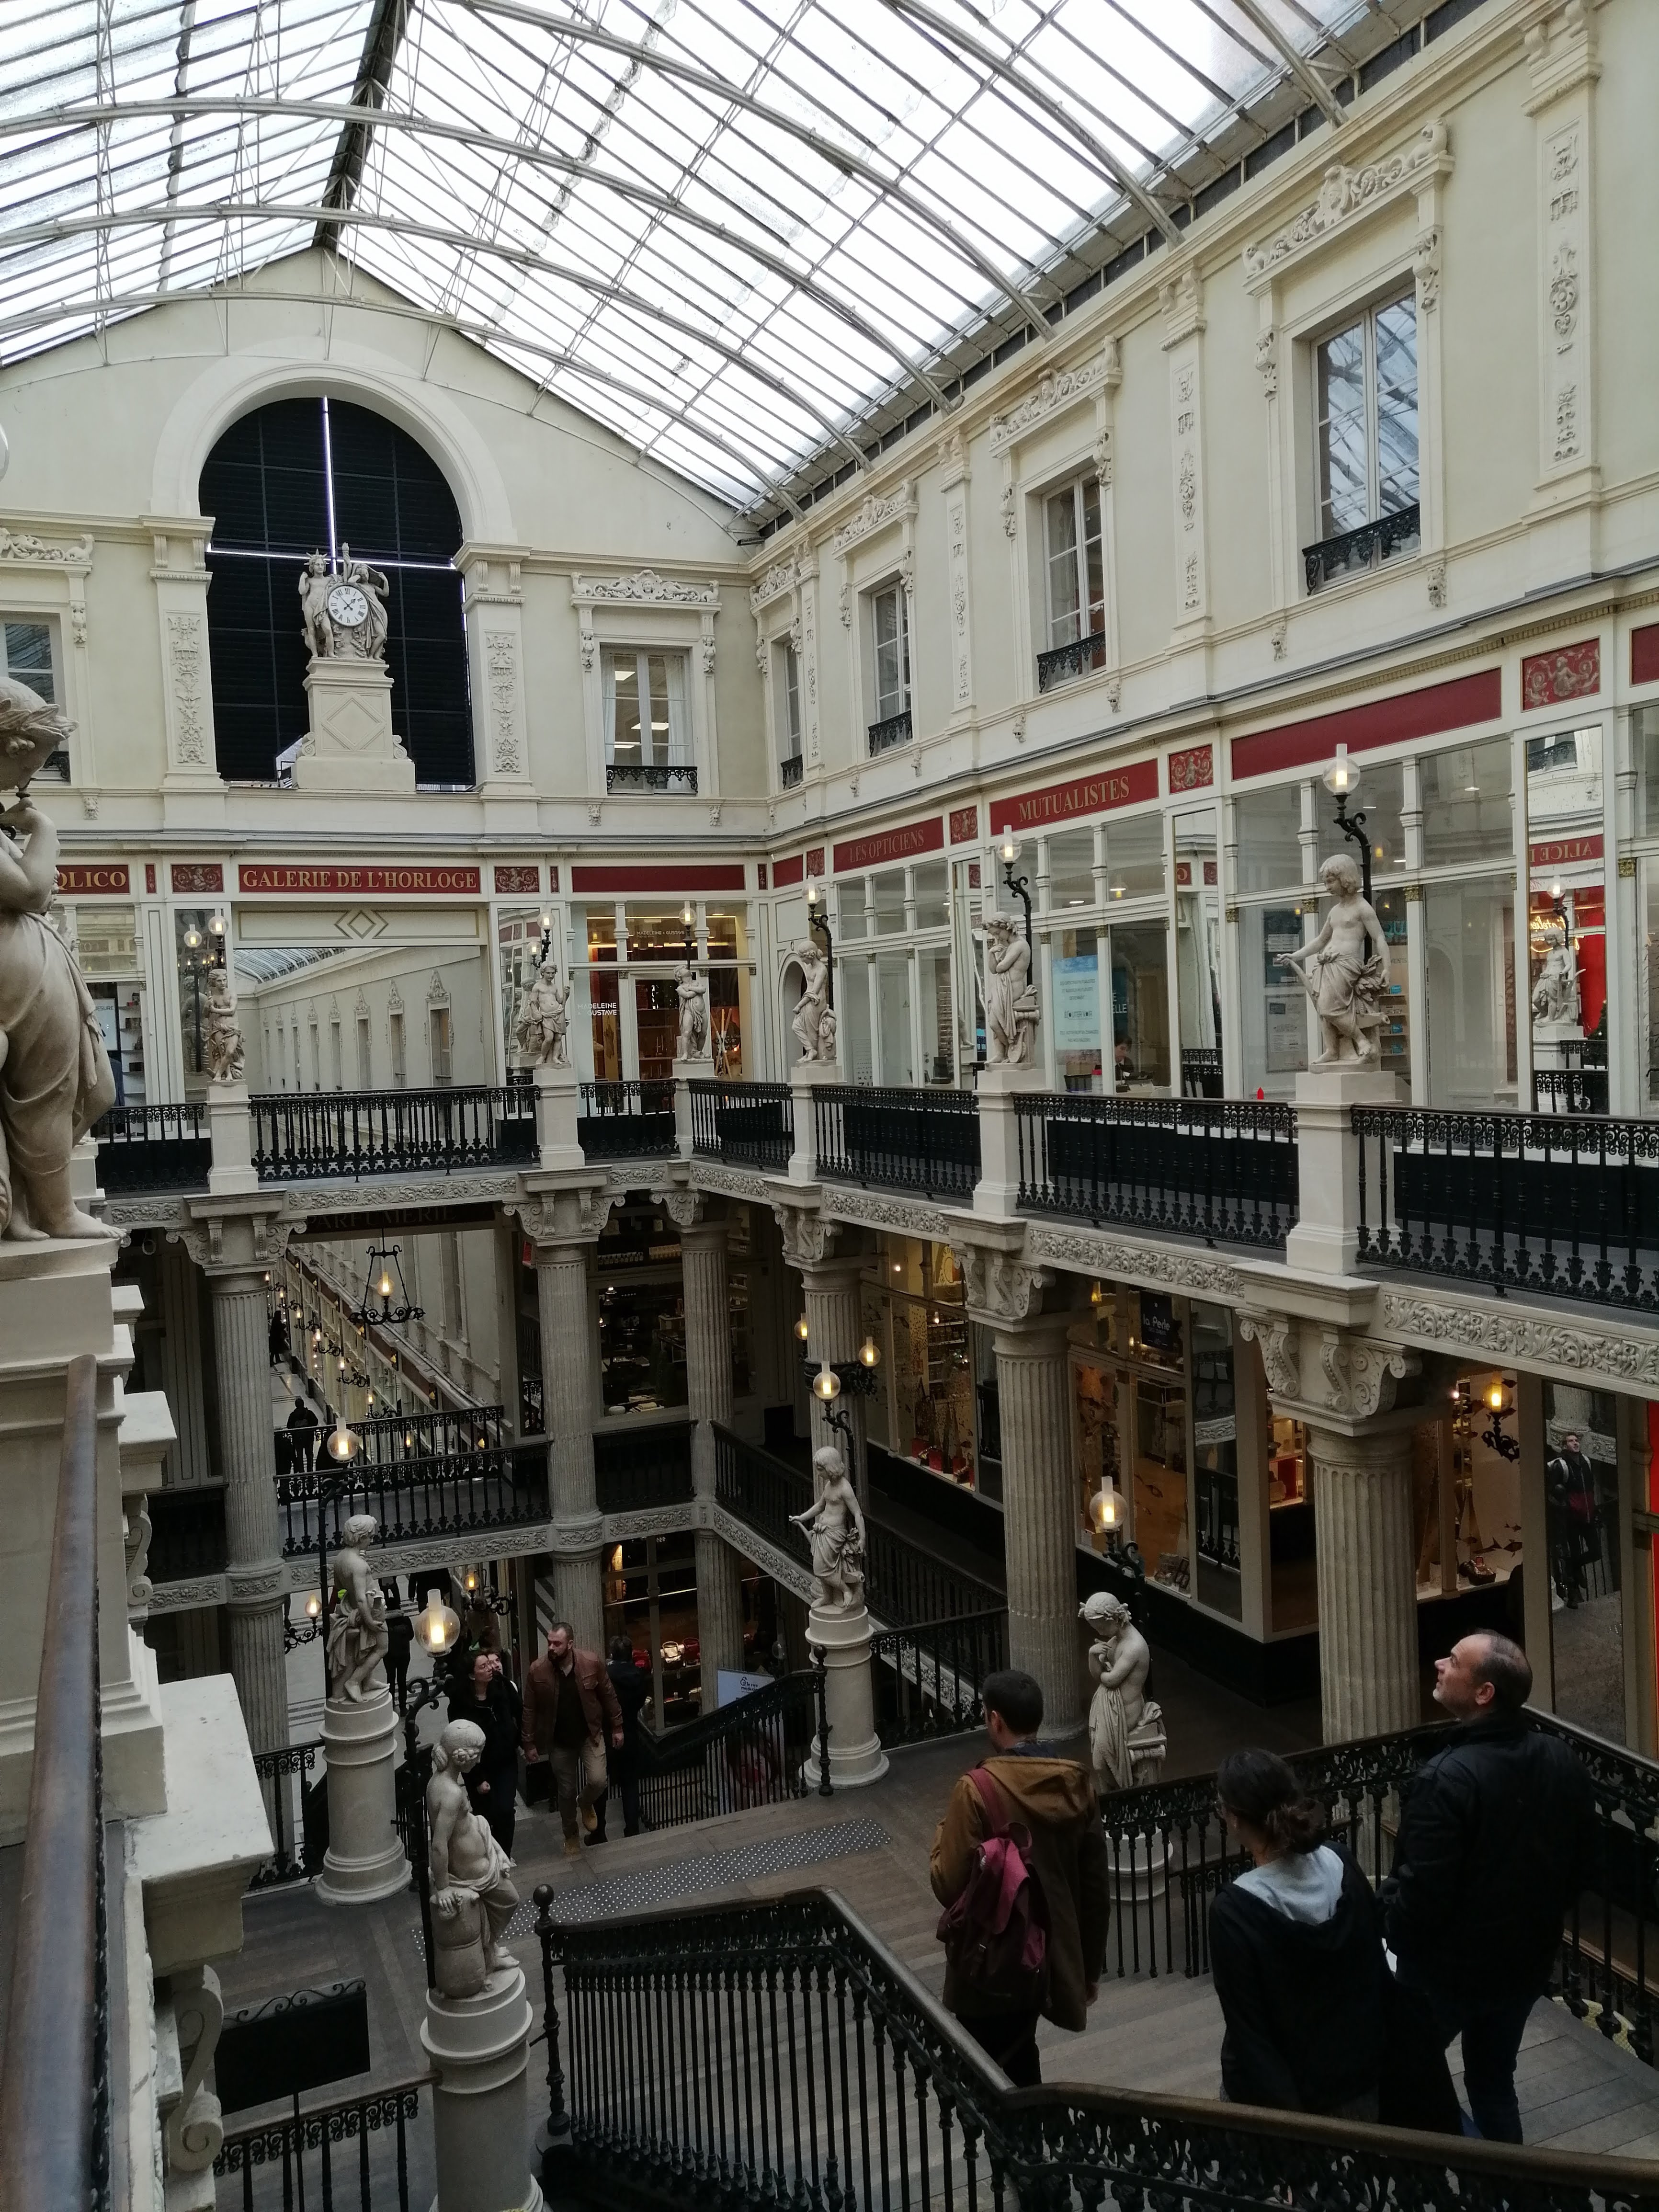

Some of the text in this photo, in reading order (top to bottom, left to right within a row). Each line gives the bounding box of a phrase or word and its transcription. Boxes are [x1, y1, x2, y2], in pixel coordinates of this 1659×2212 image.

[1019, 776, 1130, 822] MUTUALISTES
[850, 829, 924, 863] LES OPTICIENS
[243, 870, 477, 889] GALERIE DE L'HORLOGE
[1153, 1315, 1170, 1331] Perle
